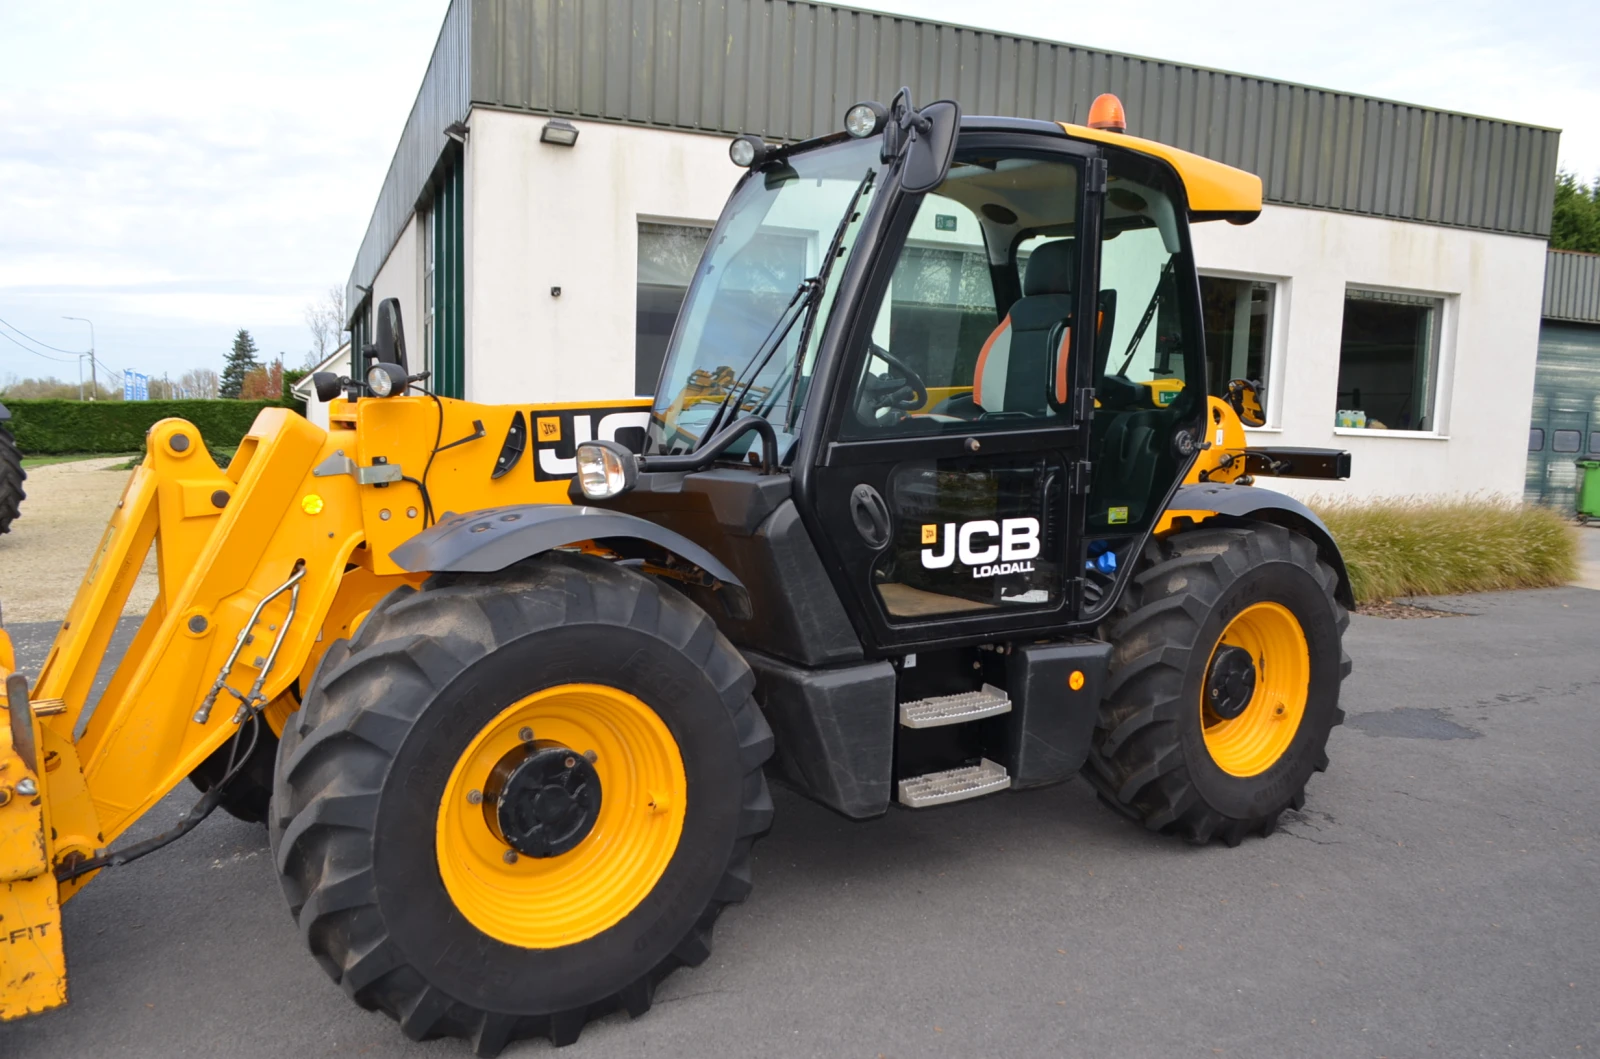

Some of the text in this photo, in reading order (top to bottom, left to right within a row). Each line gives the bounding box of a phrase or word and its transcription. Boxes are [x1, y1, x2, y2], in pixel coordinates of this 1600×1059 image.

[539, 411, 690, 474] JC
[921, 517, 1040, 569] JCB
[973, 561, 1035, 578] LOADALL
